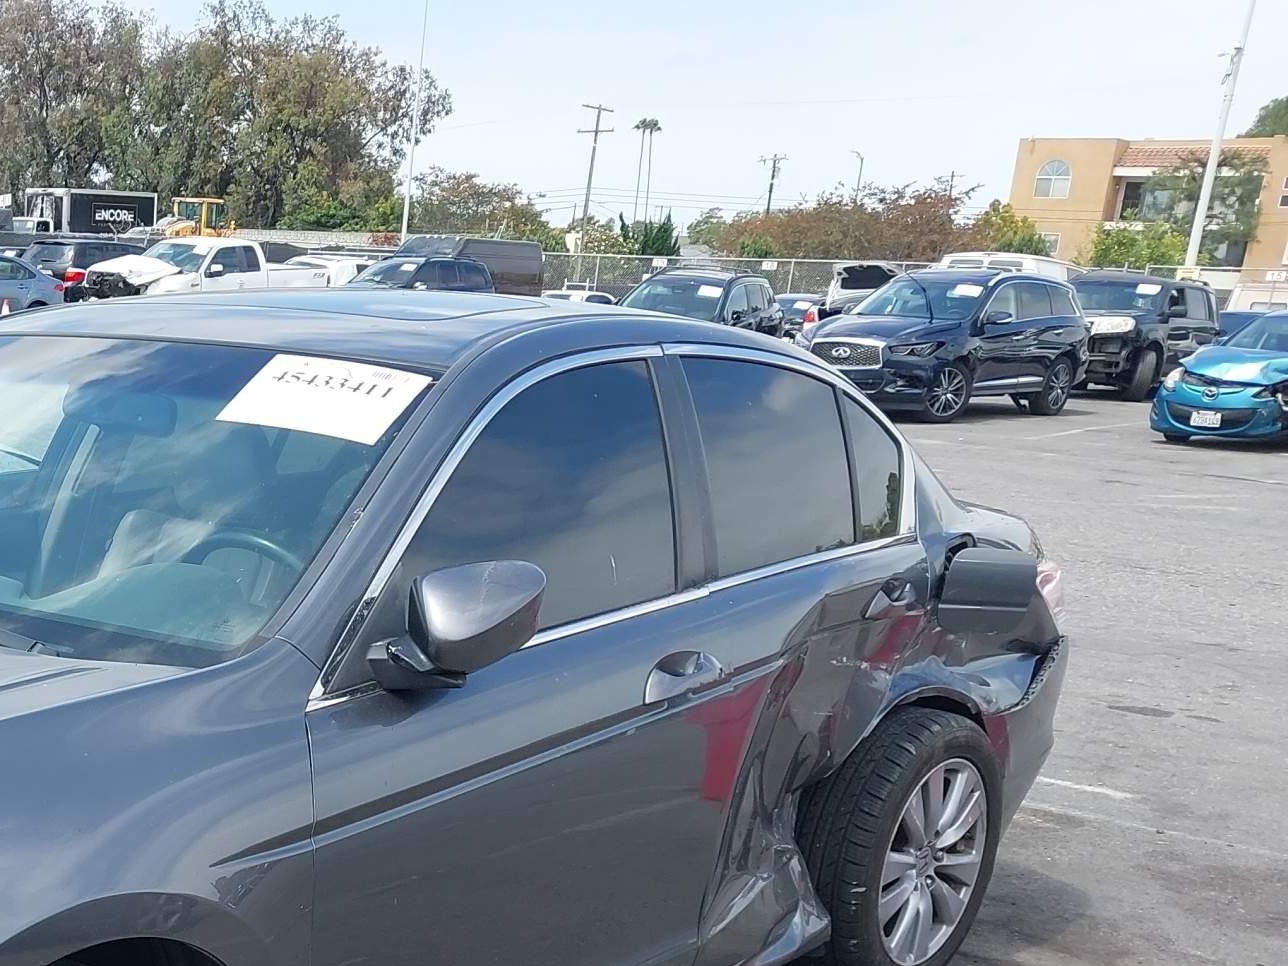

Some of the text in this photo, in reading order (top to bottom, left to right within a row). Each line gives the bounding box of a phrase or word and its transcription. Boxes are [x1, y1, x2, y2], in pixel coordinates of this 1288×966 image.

[95, 208, 135, 222] ENCORE
[1271, 271, 1282, 280] 15
[272, 370, 394, 399] 45433411
